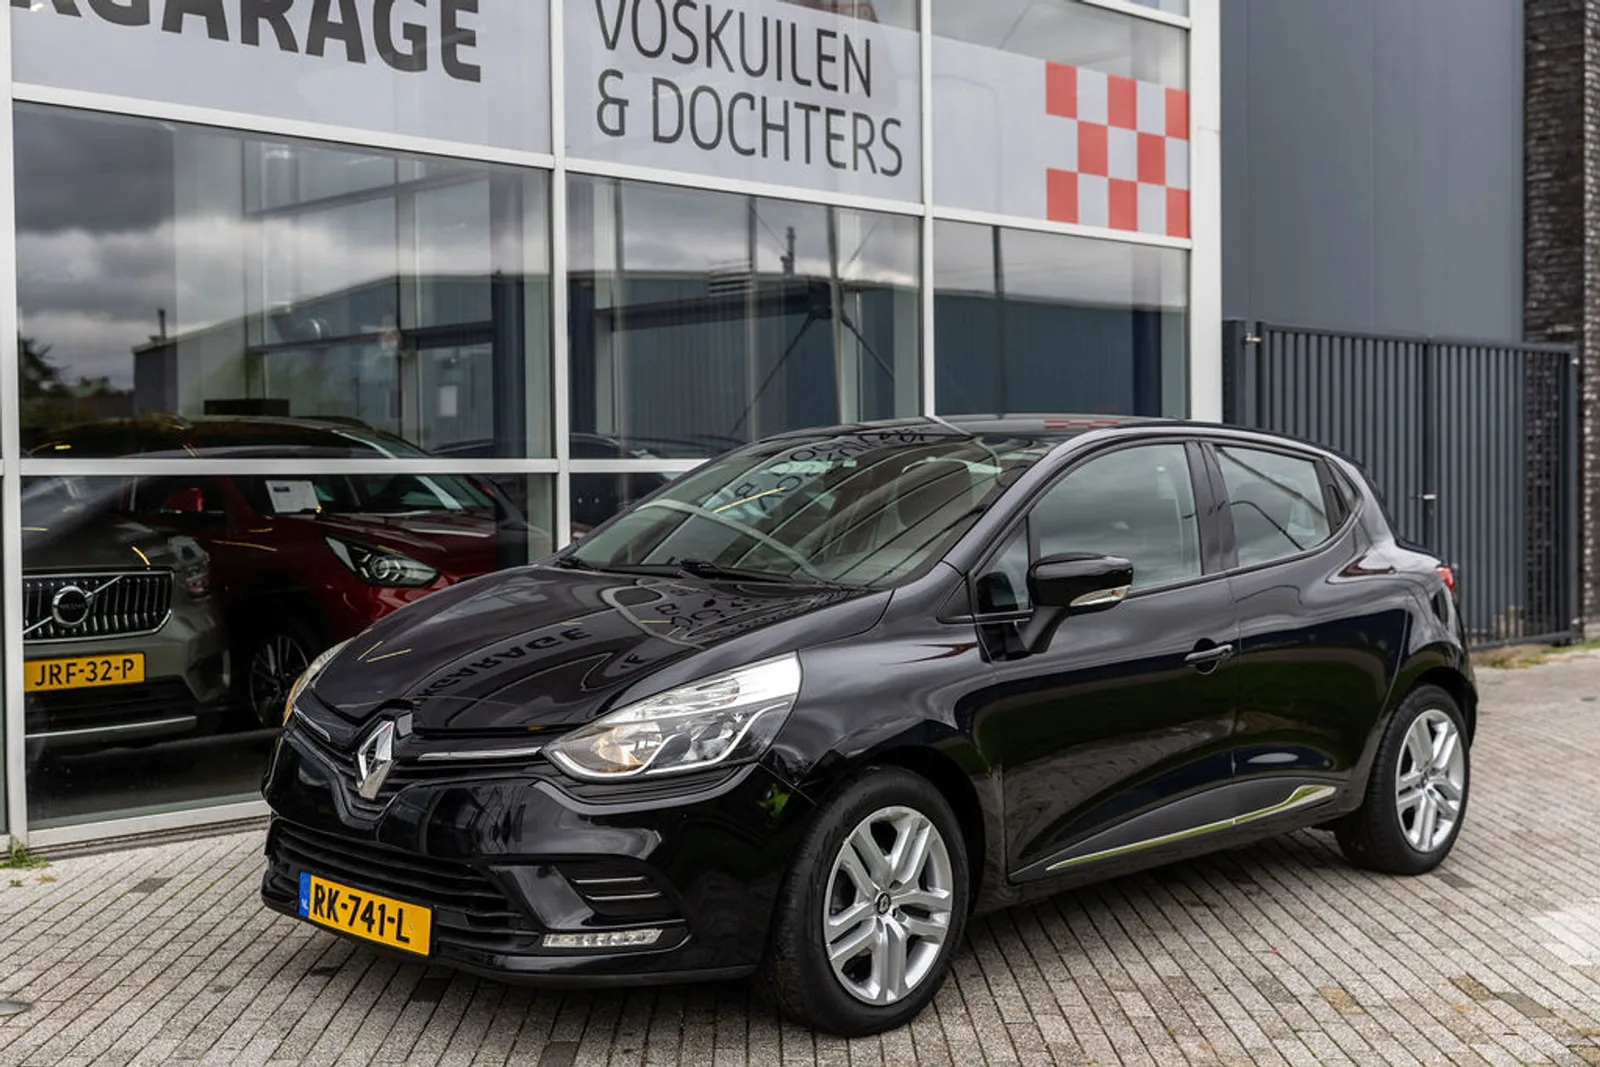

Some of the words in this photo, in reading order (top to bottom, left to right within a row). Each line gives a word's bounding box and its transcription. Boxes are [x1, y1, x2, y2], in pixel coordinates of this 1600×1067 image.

[596, 0, 872, 98] VOSKUILEN
[597, 69, 629, 137] &
[652, 76, 903, 177] DOCHTERS
[35, 658, 134, 686] JRF-32-P
[313, 883, 410, 943] RK-741-L
